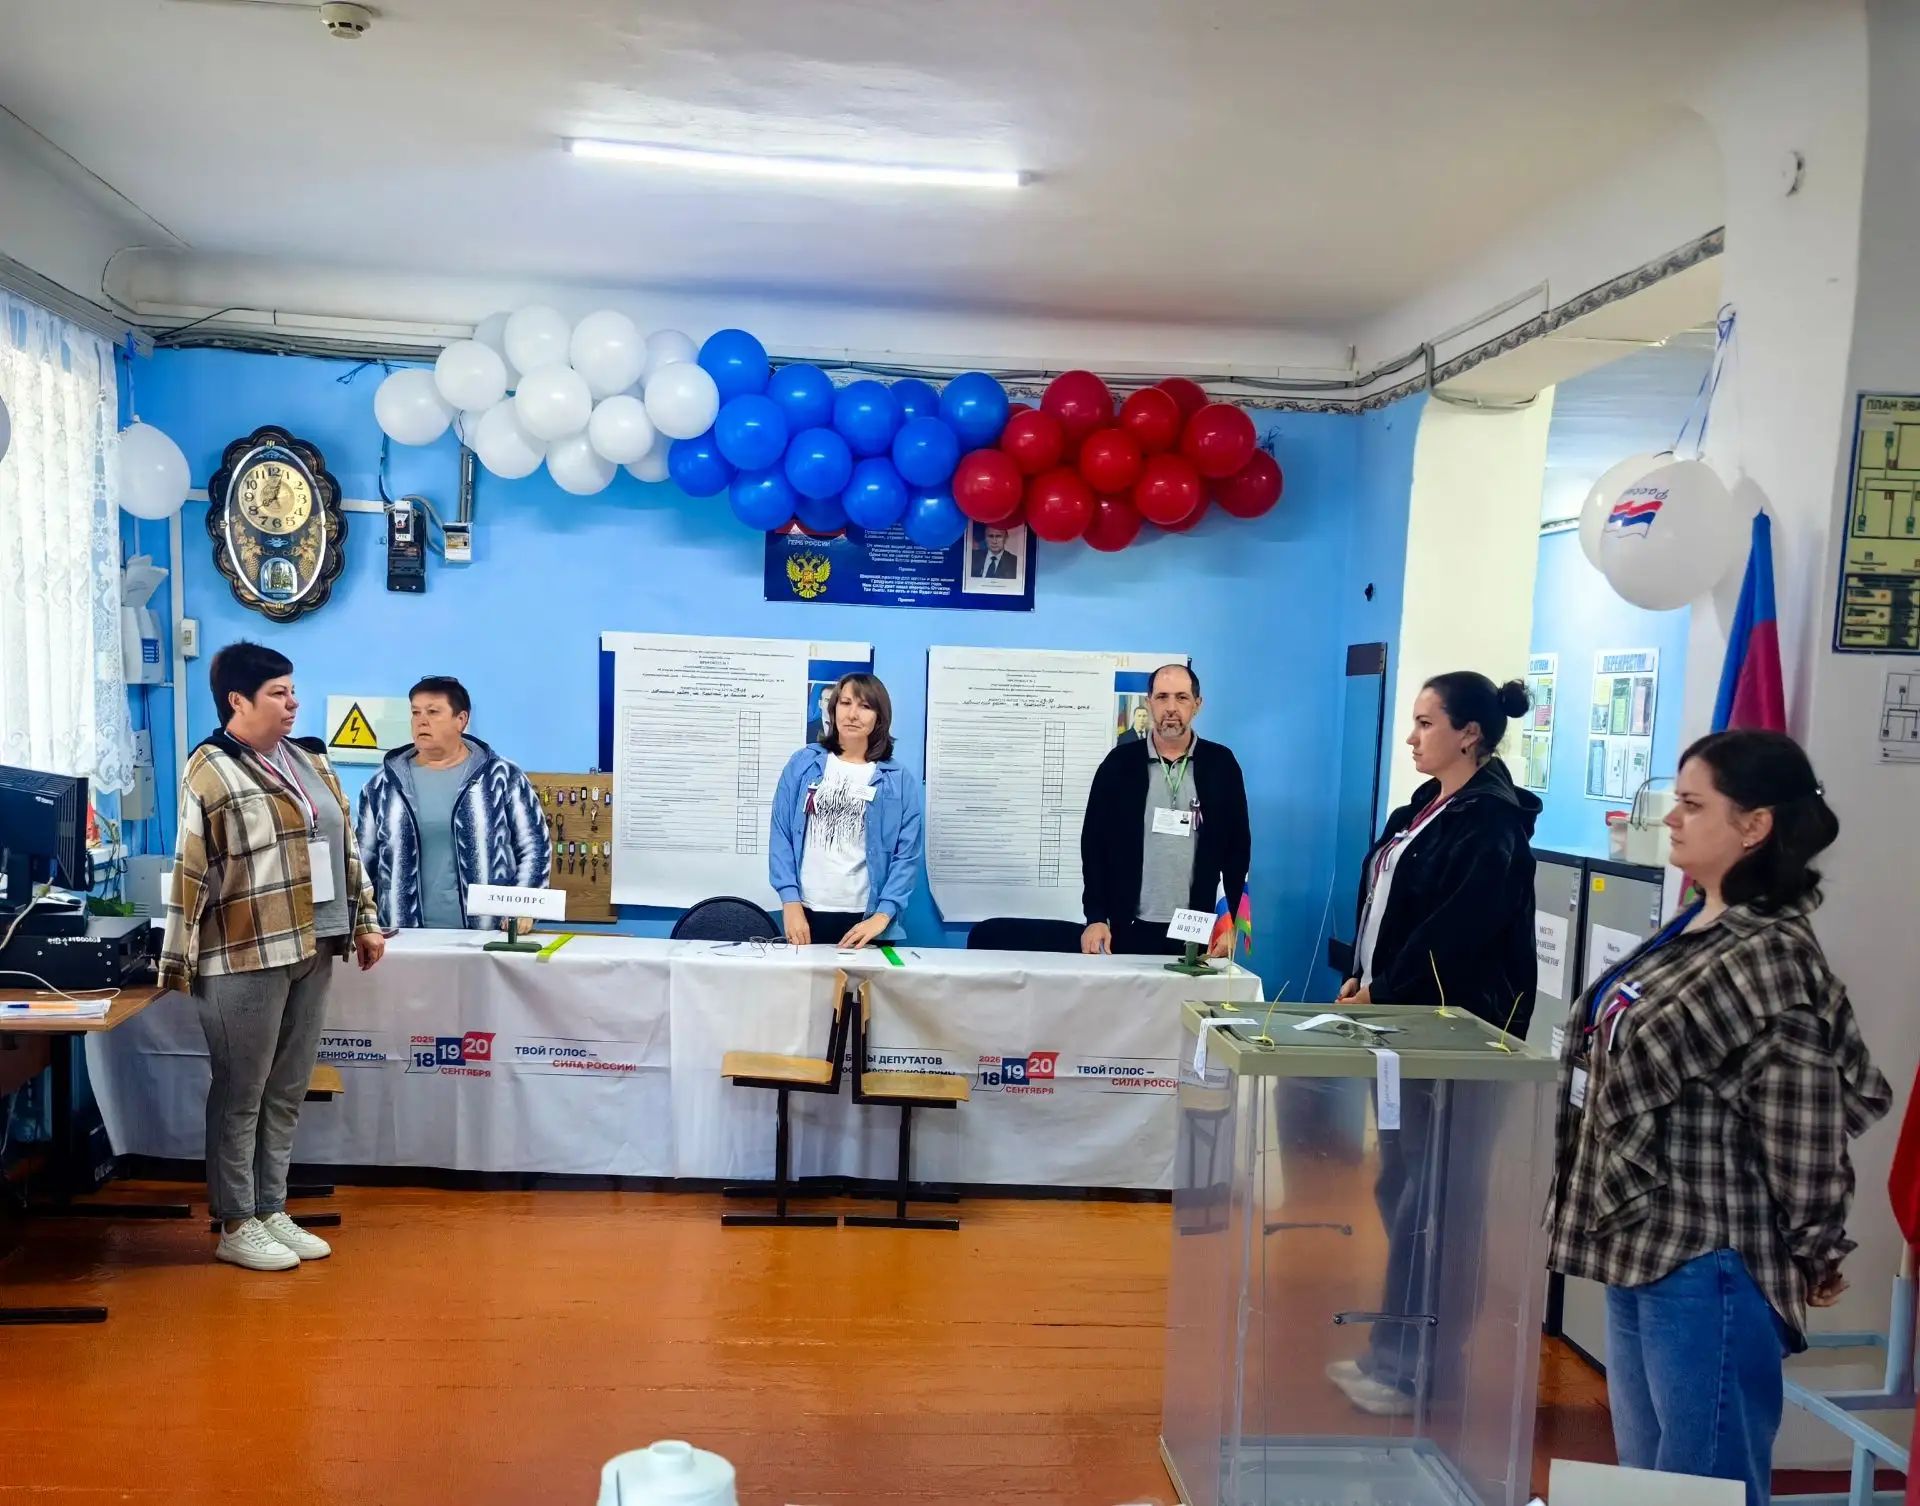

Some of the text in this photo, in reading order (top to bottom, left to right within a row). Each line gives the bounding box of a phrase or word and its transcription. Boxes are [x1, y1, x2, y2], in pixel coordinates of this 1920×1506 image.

[1866, 399, 1897, 410] ПЛАН
[246, 480, 258, 490] 10
[294, 481, 303, 490] 2
[244, 492, 254, 502] 9
[299, 494, 307, 504] 3
[248, 506, 258, 515] 8
[294, 507, 303, 516] 4
[259, 516, 268, 525] 7
[272, 518, 282, 528] 6
[286, 517, 296, 526] 5
[464, 1038, 489, 1054] 20
[515, 1045, 546, 1055] ТВОЙ
[549, 1047, 587, 1057] ГОЛОС
[357, 1052, 387, 1061] ДУМЫ
[439, 1044, 460, 1060] 19
[414, 1052, 435, 1067] 18
[879, 1055, 943, 1065] ДЕПУТАТОВ
[552, 1060, 637, 1071] СИЛА РОССИИ!
[1028, 1058, 1053, 1073] 20
[1077, 1064, 1106, 1074] ТВОЙ
[1109, 1066, 1145, 1076] ГОЛОС
[441, 1067, 491, 1077] СЕНТЯБРЯ
[1004, 1064, 1025, 1079] 19
[980, 1071, 1000, 1086] 18
[1111, 1078, 1141, 1087] СИЛА
[1006, 1086, 1054, 1095] СЕНТЯБРЯ
